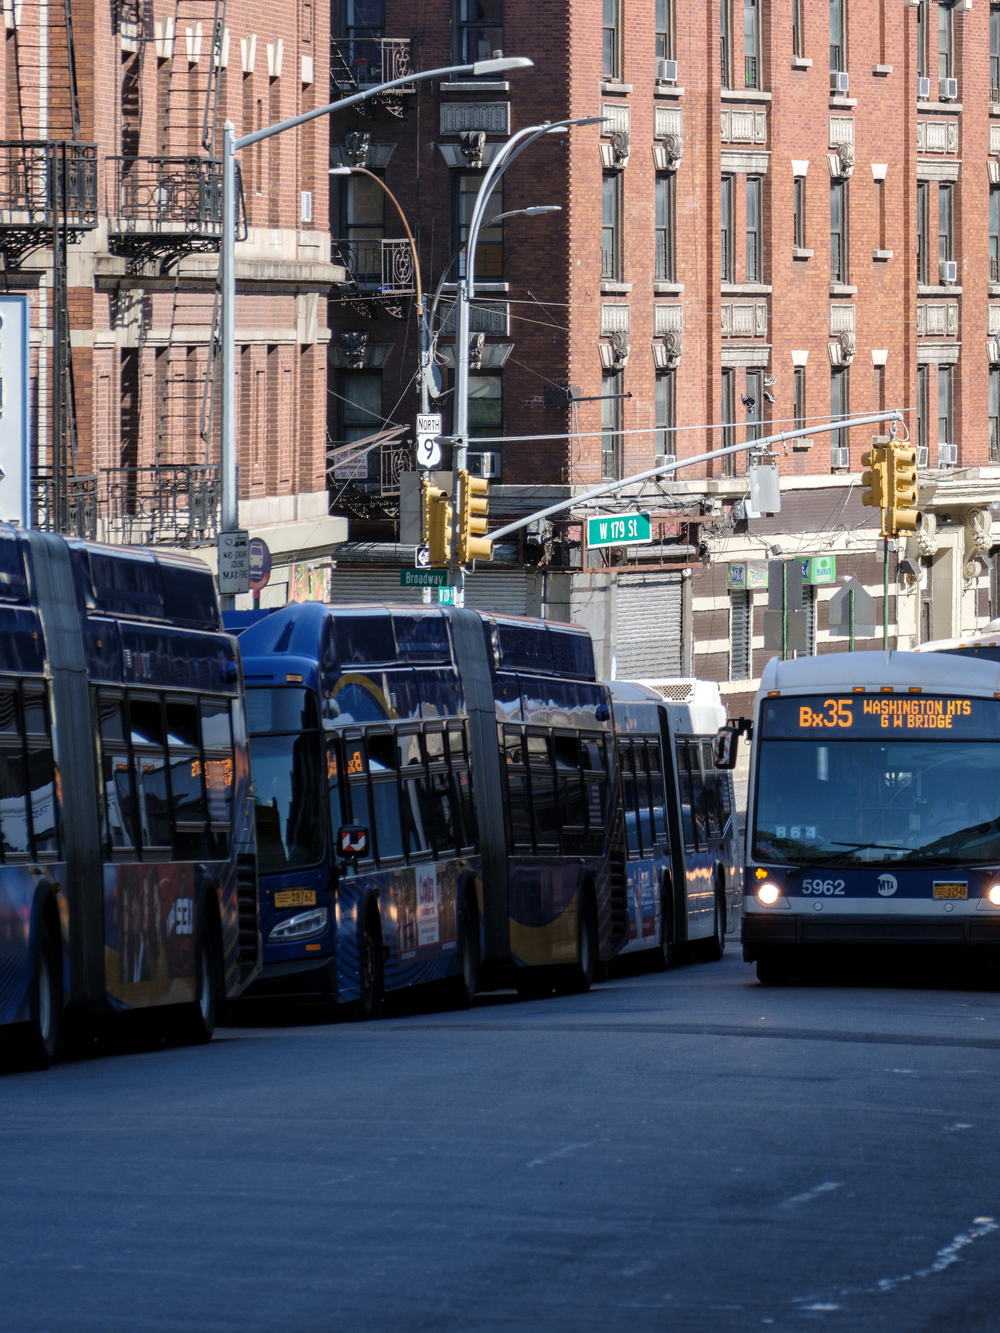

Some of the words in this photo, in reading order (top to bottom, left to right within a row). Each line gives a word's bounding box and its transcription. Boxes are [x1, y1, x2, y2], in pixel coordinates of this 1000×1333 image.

[418, 418, 440, 432] NORTH
[424, 438, 433, 460] 9
[600, 523, 608, 540] W
[611, 521, 625, 539] 179
[628, 519, 638, 537] St
[405, 572, 444, 586] Broadway
[799, 699, 853, 727] Bx35
[863, 700, 942, 715] WASHINGTON
[947, 700, 972, 715] HTS
[880, 715, 889, 728] G
[893, 715, 903, 728] W
[907, 715, 953, 728] BRIDGE
[801, 879, 846, 895] 5962
[877, 878, 895, 892] MTA
